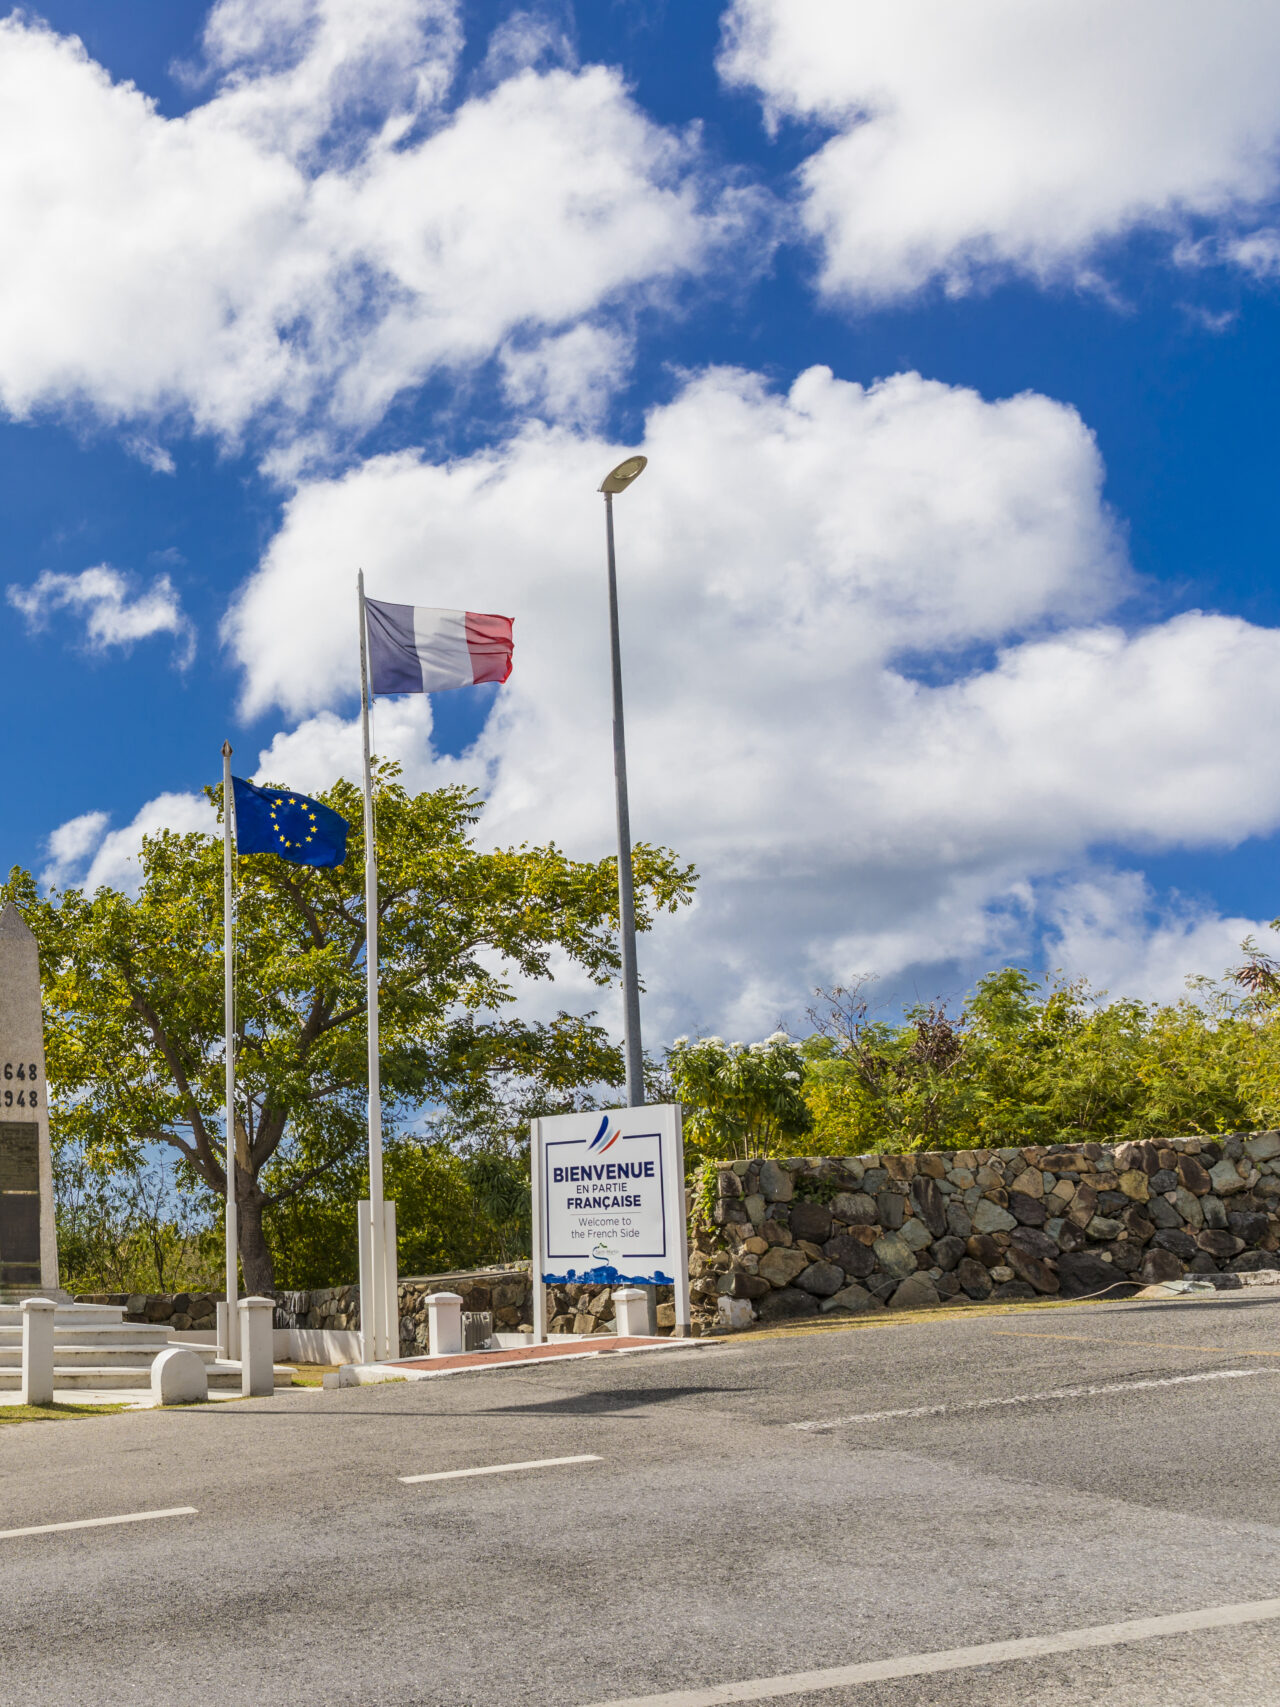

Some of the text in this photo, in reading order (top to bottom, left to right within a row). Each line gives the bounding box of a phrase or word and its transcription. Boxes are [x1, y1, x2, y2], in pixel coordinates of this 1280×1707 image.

[554, 1161, 655, 1183] BIENVENUE
[577, 1183, 627, 1193] EN PARTIE
[567, 1195, 641, 1210] FRANÇAISE
[579, 1218, 619, 1227] Welcome
[571, 1229, 639, 1238] the French Side
